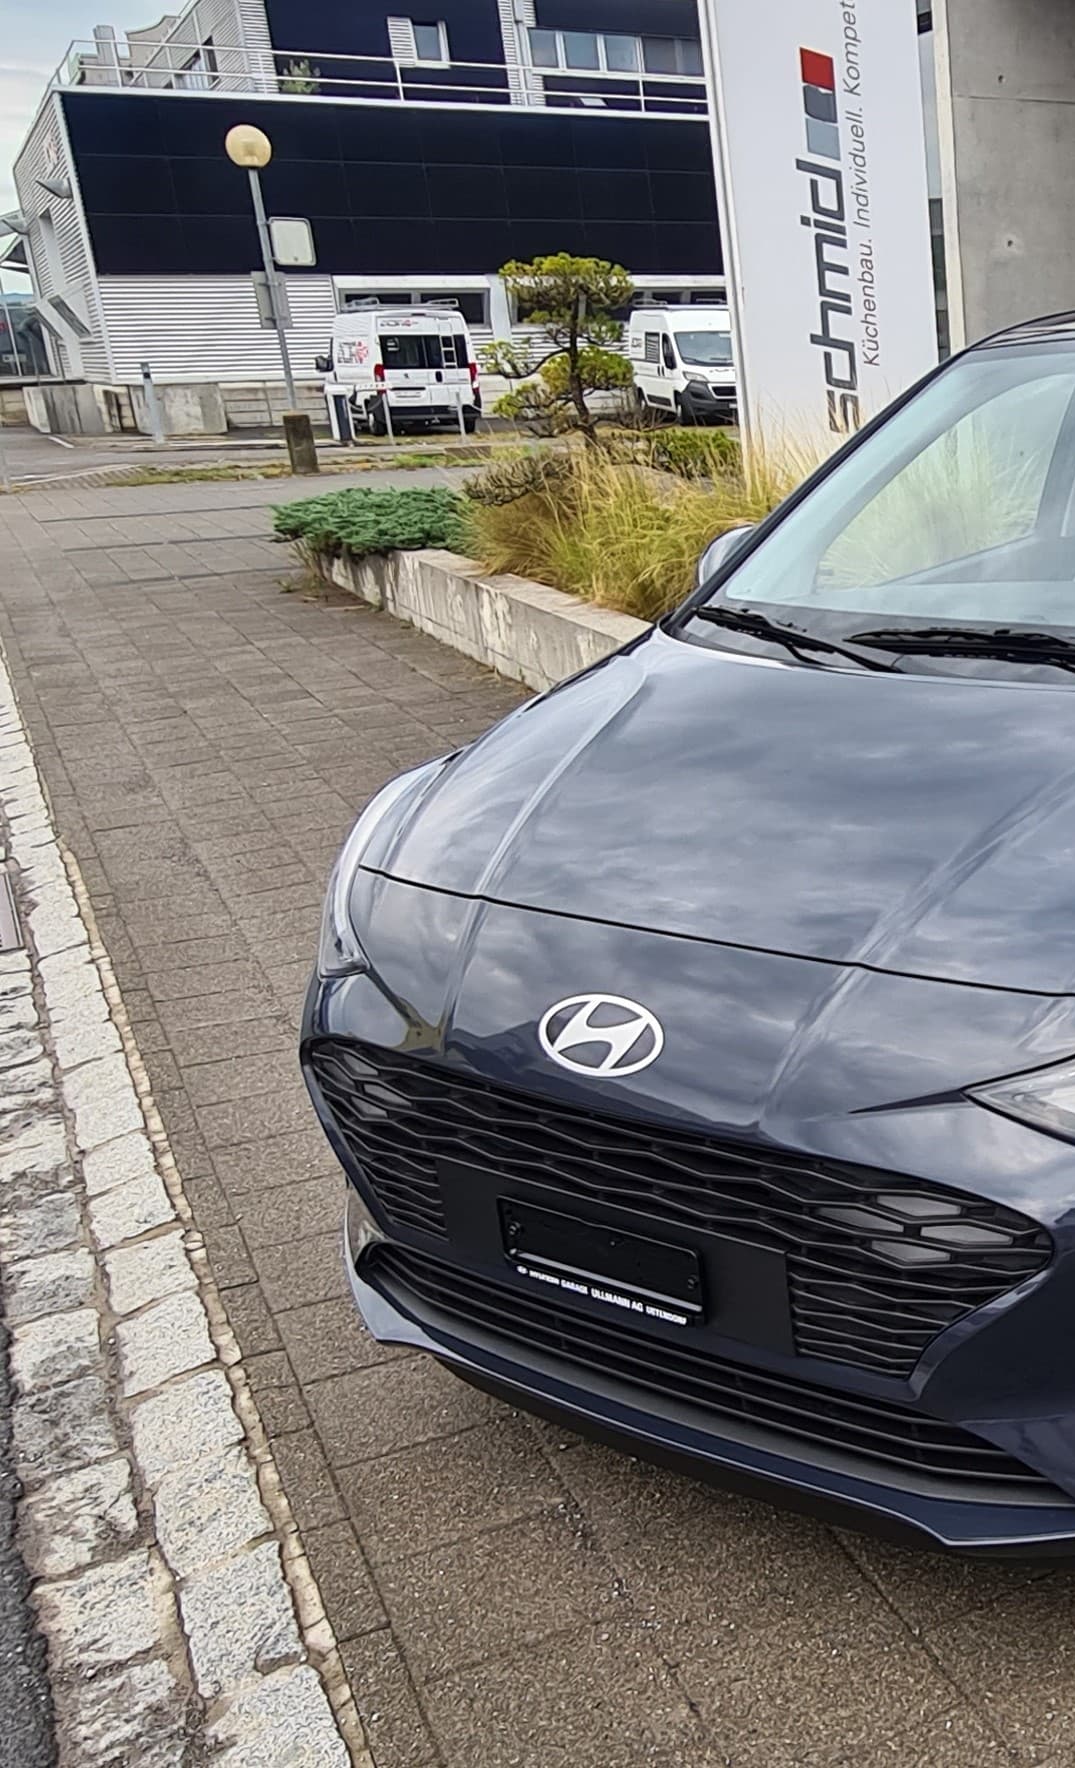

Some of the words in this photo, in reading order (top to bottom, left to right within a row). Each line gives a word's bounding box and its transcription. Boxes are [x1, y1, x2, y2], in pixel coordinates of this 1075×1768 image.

[840, 0, 862, 97] Kompet
[844, 107, 871, 228] Individuell.
[795, 158, 860, 433] schmid
[857, 238, 880, 366] Küchenbau.
